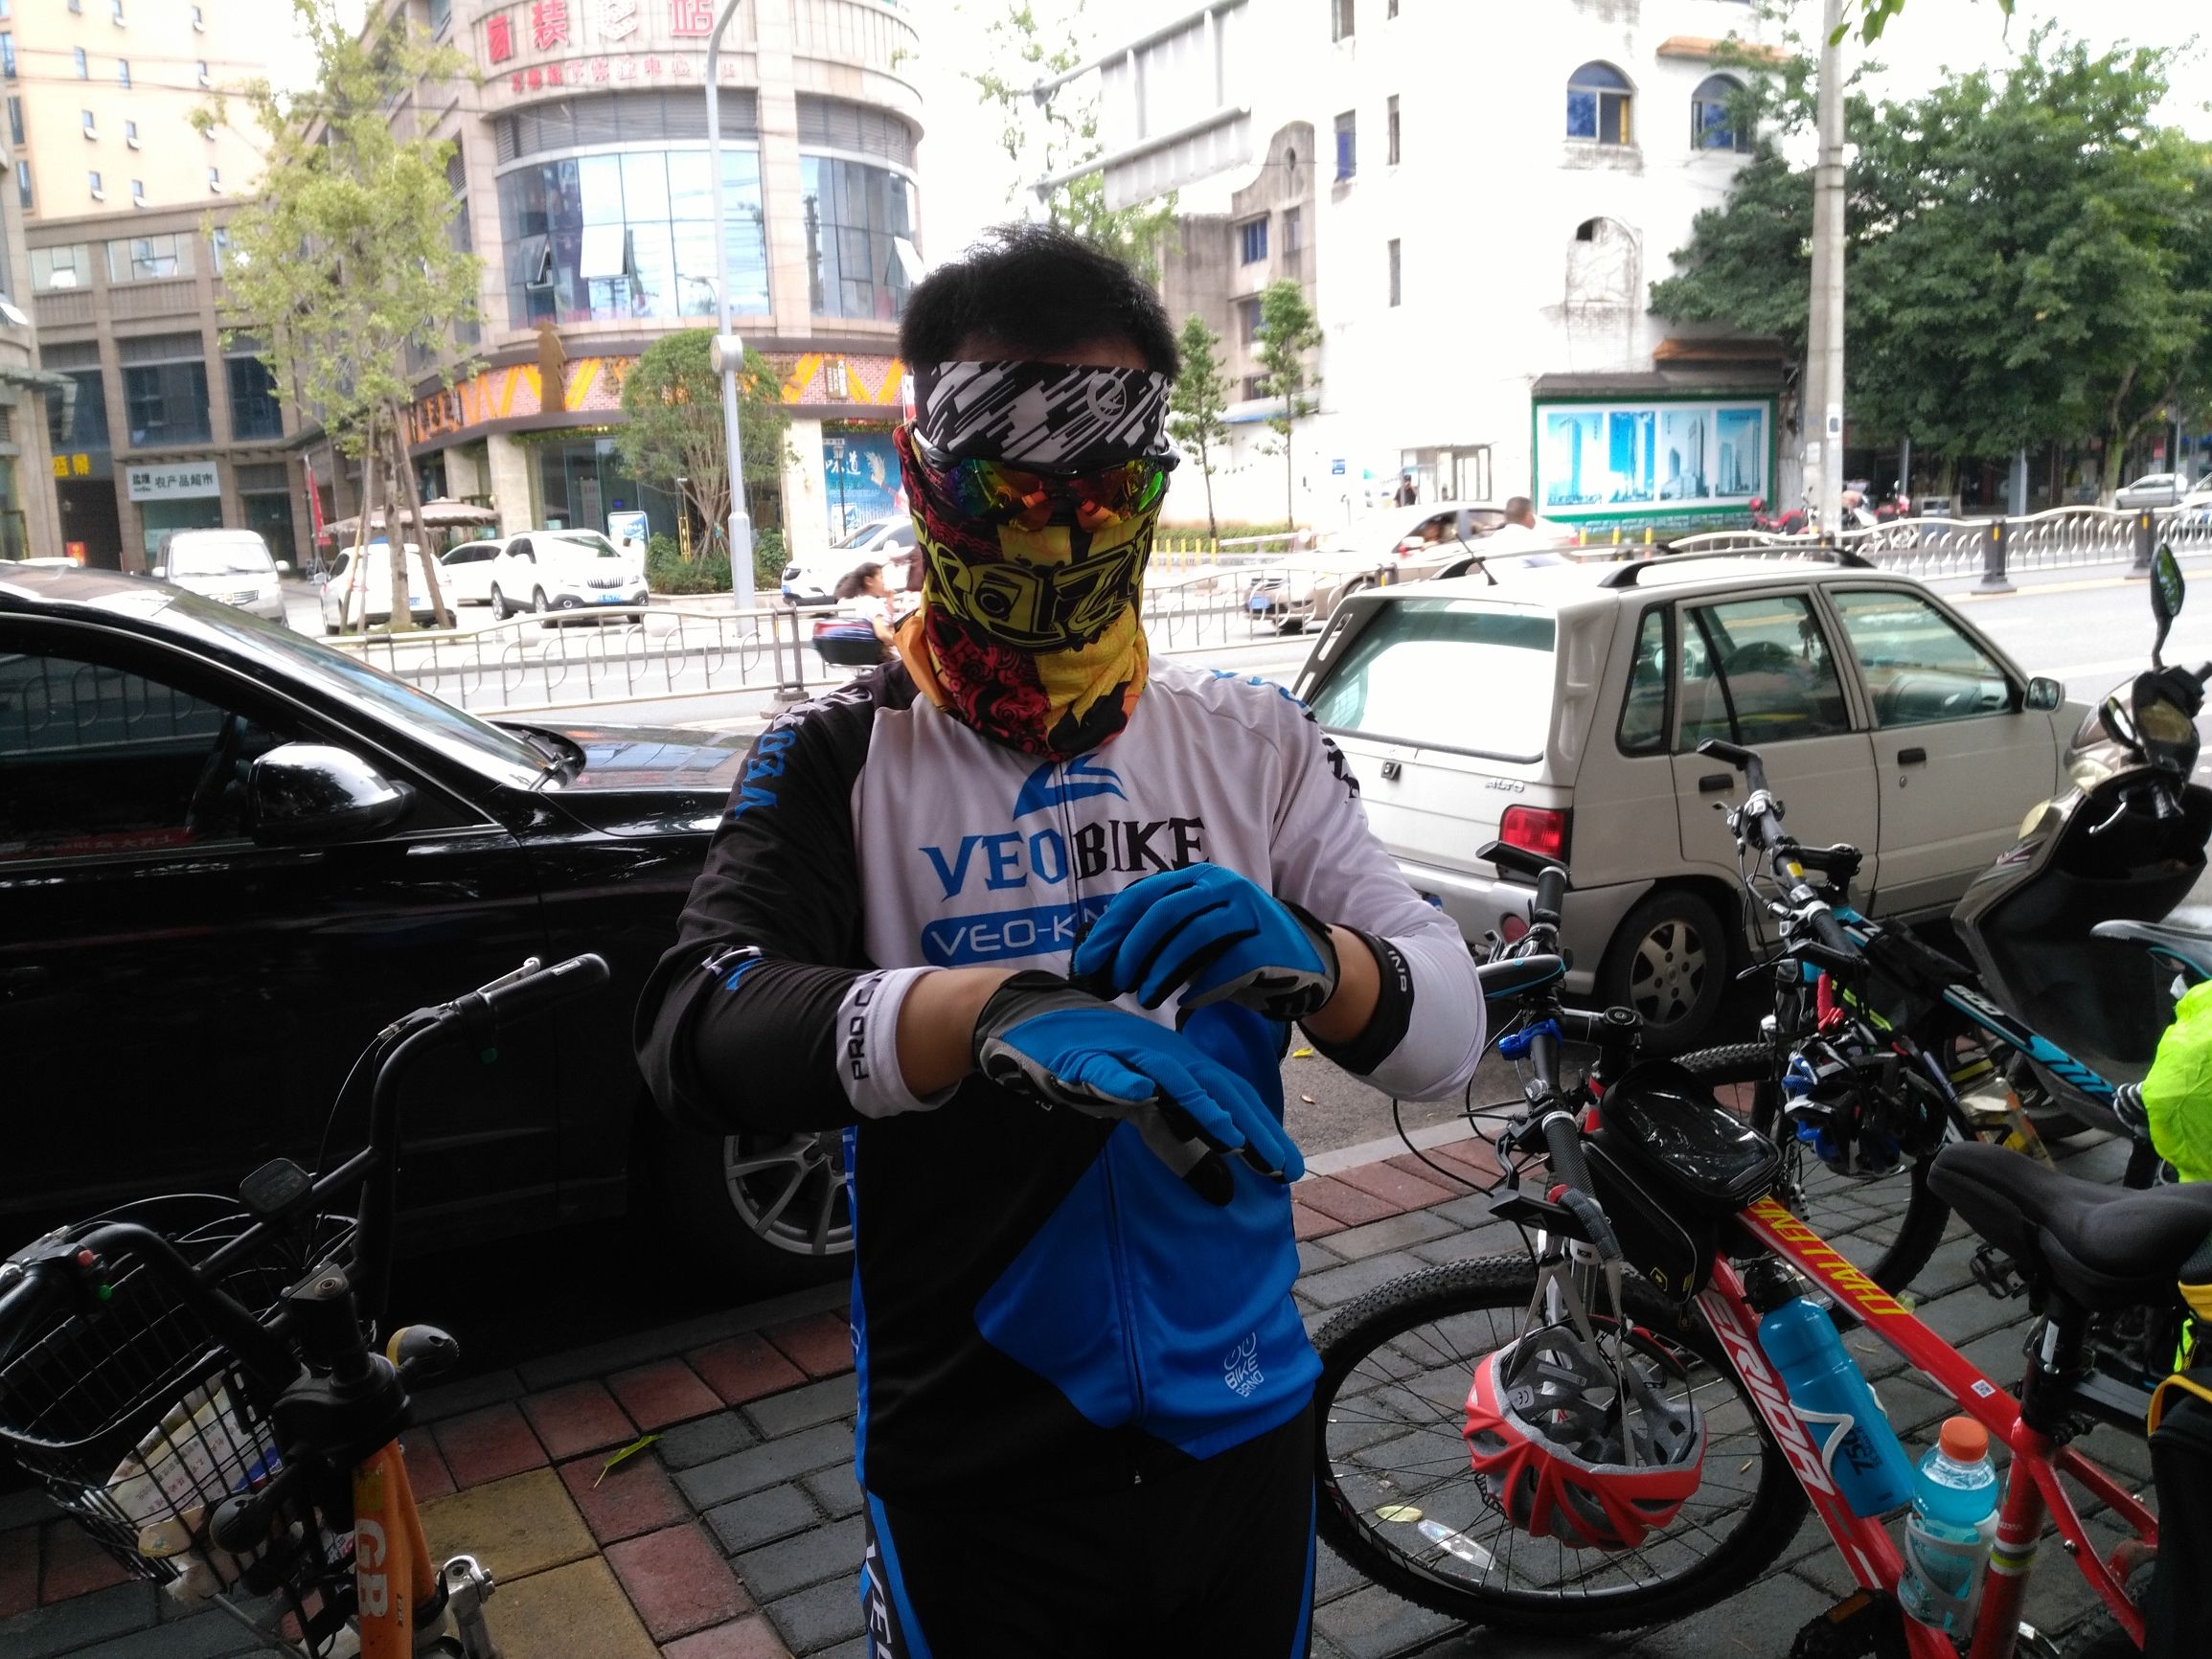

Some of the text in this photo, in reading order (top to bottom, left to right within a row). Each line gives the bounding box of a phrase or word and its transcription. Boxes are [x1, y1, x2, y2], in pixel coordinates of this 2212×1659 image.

[1224, 1352, 1259, 1391] BIKE
[1235, 1370, 1265, 1398] BRNO
[354, 1517, 388, 1619] GB
